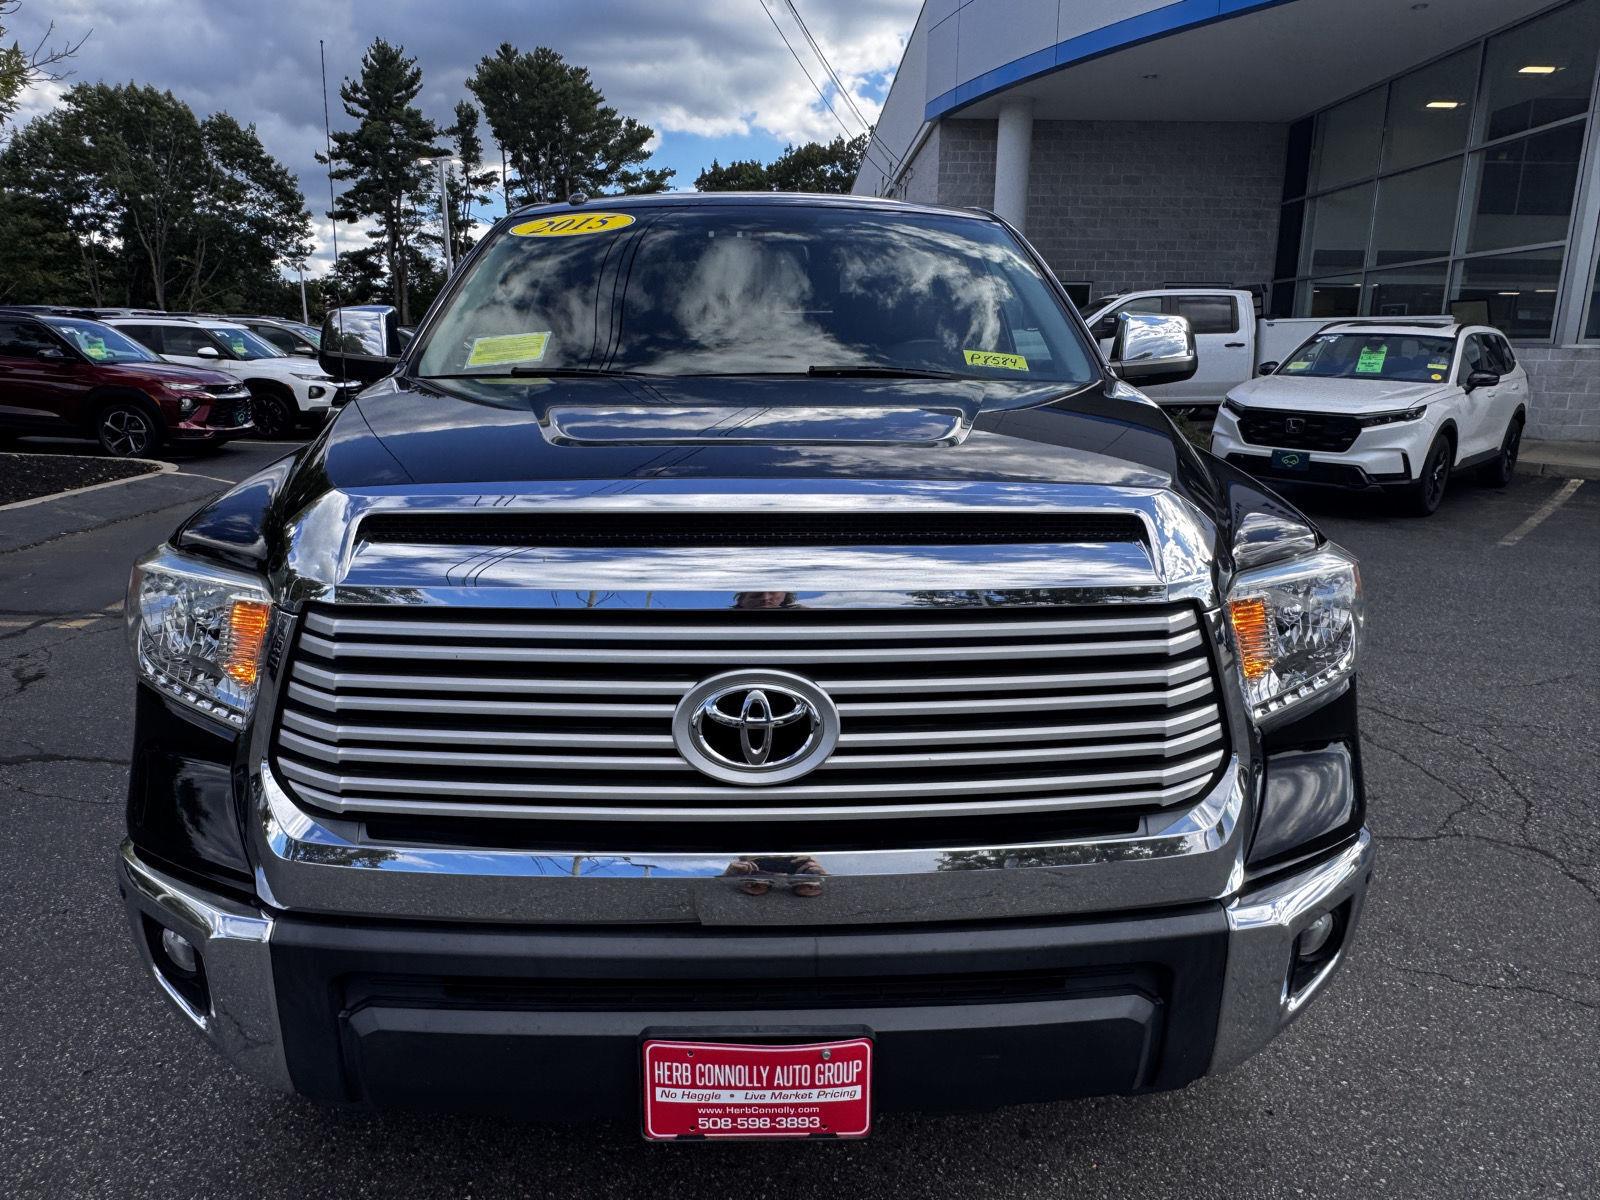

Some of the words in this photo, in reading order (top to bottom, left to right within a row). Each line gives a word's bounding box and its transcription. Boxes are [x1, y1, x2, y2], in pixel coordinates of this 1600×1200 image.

[527, 216, 616, 234] 2015
[655, 1061, 691, 1086] HERB
[696, 1063, 769, 1087] CONNOLLY
[774, 1064, 810, 1087] AUTO
[815, 1060, 862, 1085] GROUP
[660, 1089, 677, 1099] No
[681, 1091, 721, 1102] Haggle
[744, 1092, 766, 1100] Live
[770, 1091, 813, 1100] Market
[817, 1089, 857, 1099] Pricing
[697, 1106, 820, 1114] www.HerbConnolly.com
[698, 1116, 820, 1129] 508-598-3893
